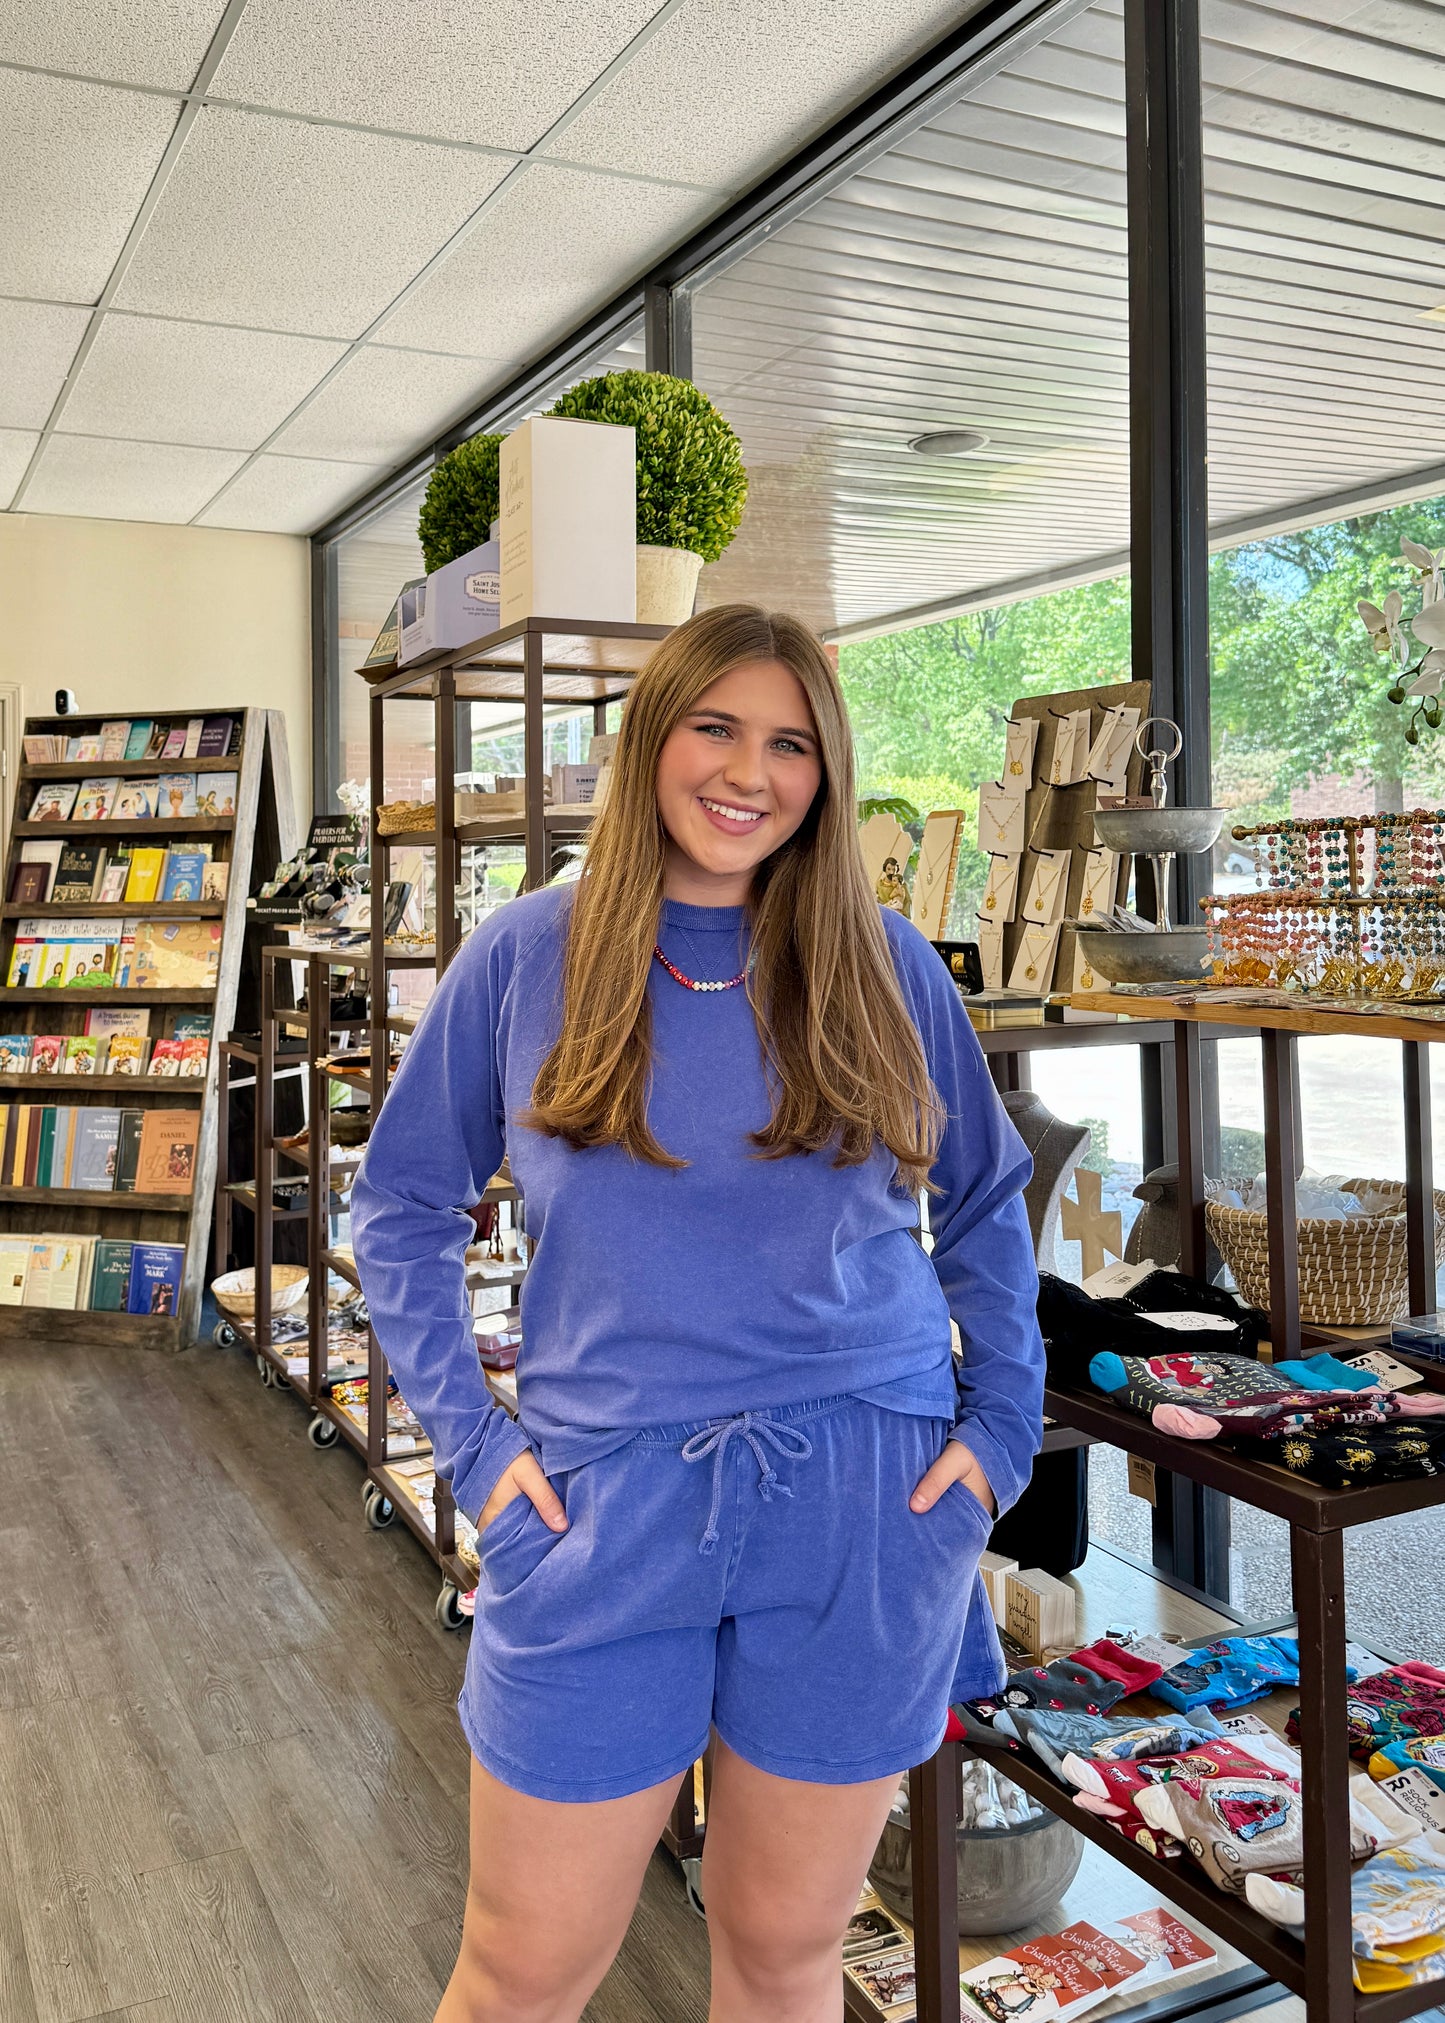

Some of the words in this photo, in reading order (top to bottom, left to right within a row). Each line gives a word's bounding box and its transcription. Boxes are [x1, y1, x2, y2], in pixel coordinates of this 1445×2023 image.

[312, 835, 336, 843] EVERYDAY
[314, 827, 335, 835] PRAYERS
[145, 1270, 165, 1278] MARK
[1368, 1364, 1390, 1377] SOCK
[1407, 1788, 1431, 1808] SOCK
[1400, 1791, 1440, 1828] RELIGIOUS
[1091, 1934, 1105, 1944] I
[1101, 1940, 1121, 1957] Can
[1135, 1914, 1173, 1936] Change
[1176, 1939, 1203, 1960] World!
[1173, 1927, 1193, 1943] Can
[1052, 1950, 1067, 1960] I
[1061, 1956, 1081, 1975] Can
[1060, 1931, 1100, 1951] Change
[1105, 1954, 1135, 1977] World!
[1022, 1945, 1059, 1967] Change
[1062, 1971, 1090, 1995] World!
